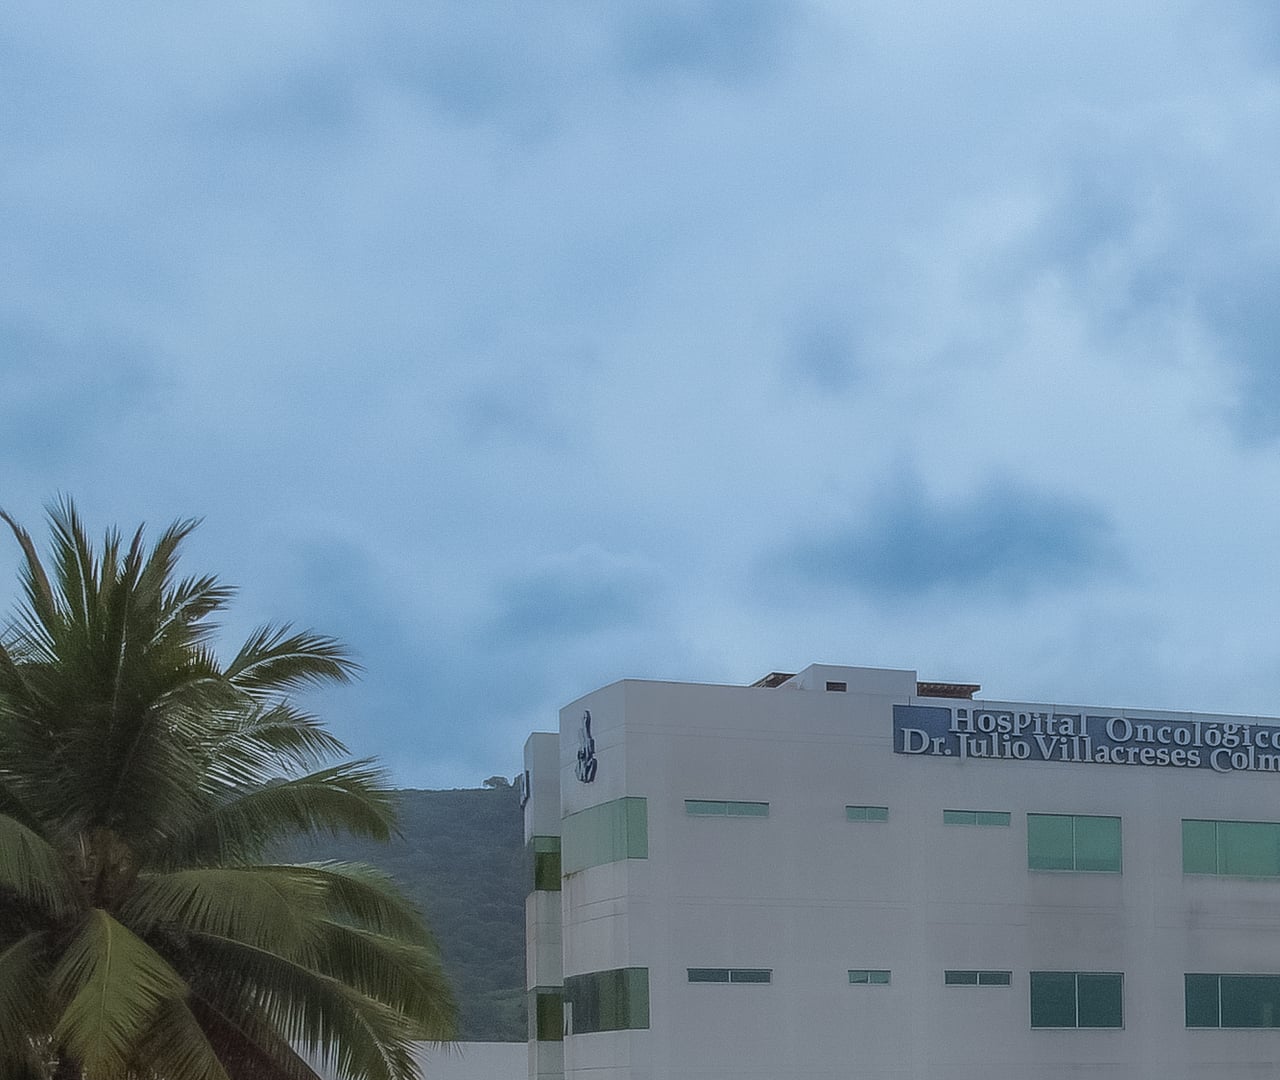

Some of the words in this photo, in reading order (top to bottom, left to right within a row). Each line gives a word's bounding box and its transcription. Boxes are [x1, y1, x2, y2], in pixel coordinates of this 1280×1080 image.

[948, 706, 1089, 738] Hospital
[900, 727, 952, 756] Dr.
[956, 731, 1031, 762] Julio
[1033, 734, 1200, 768] Villacreses
